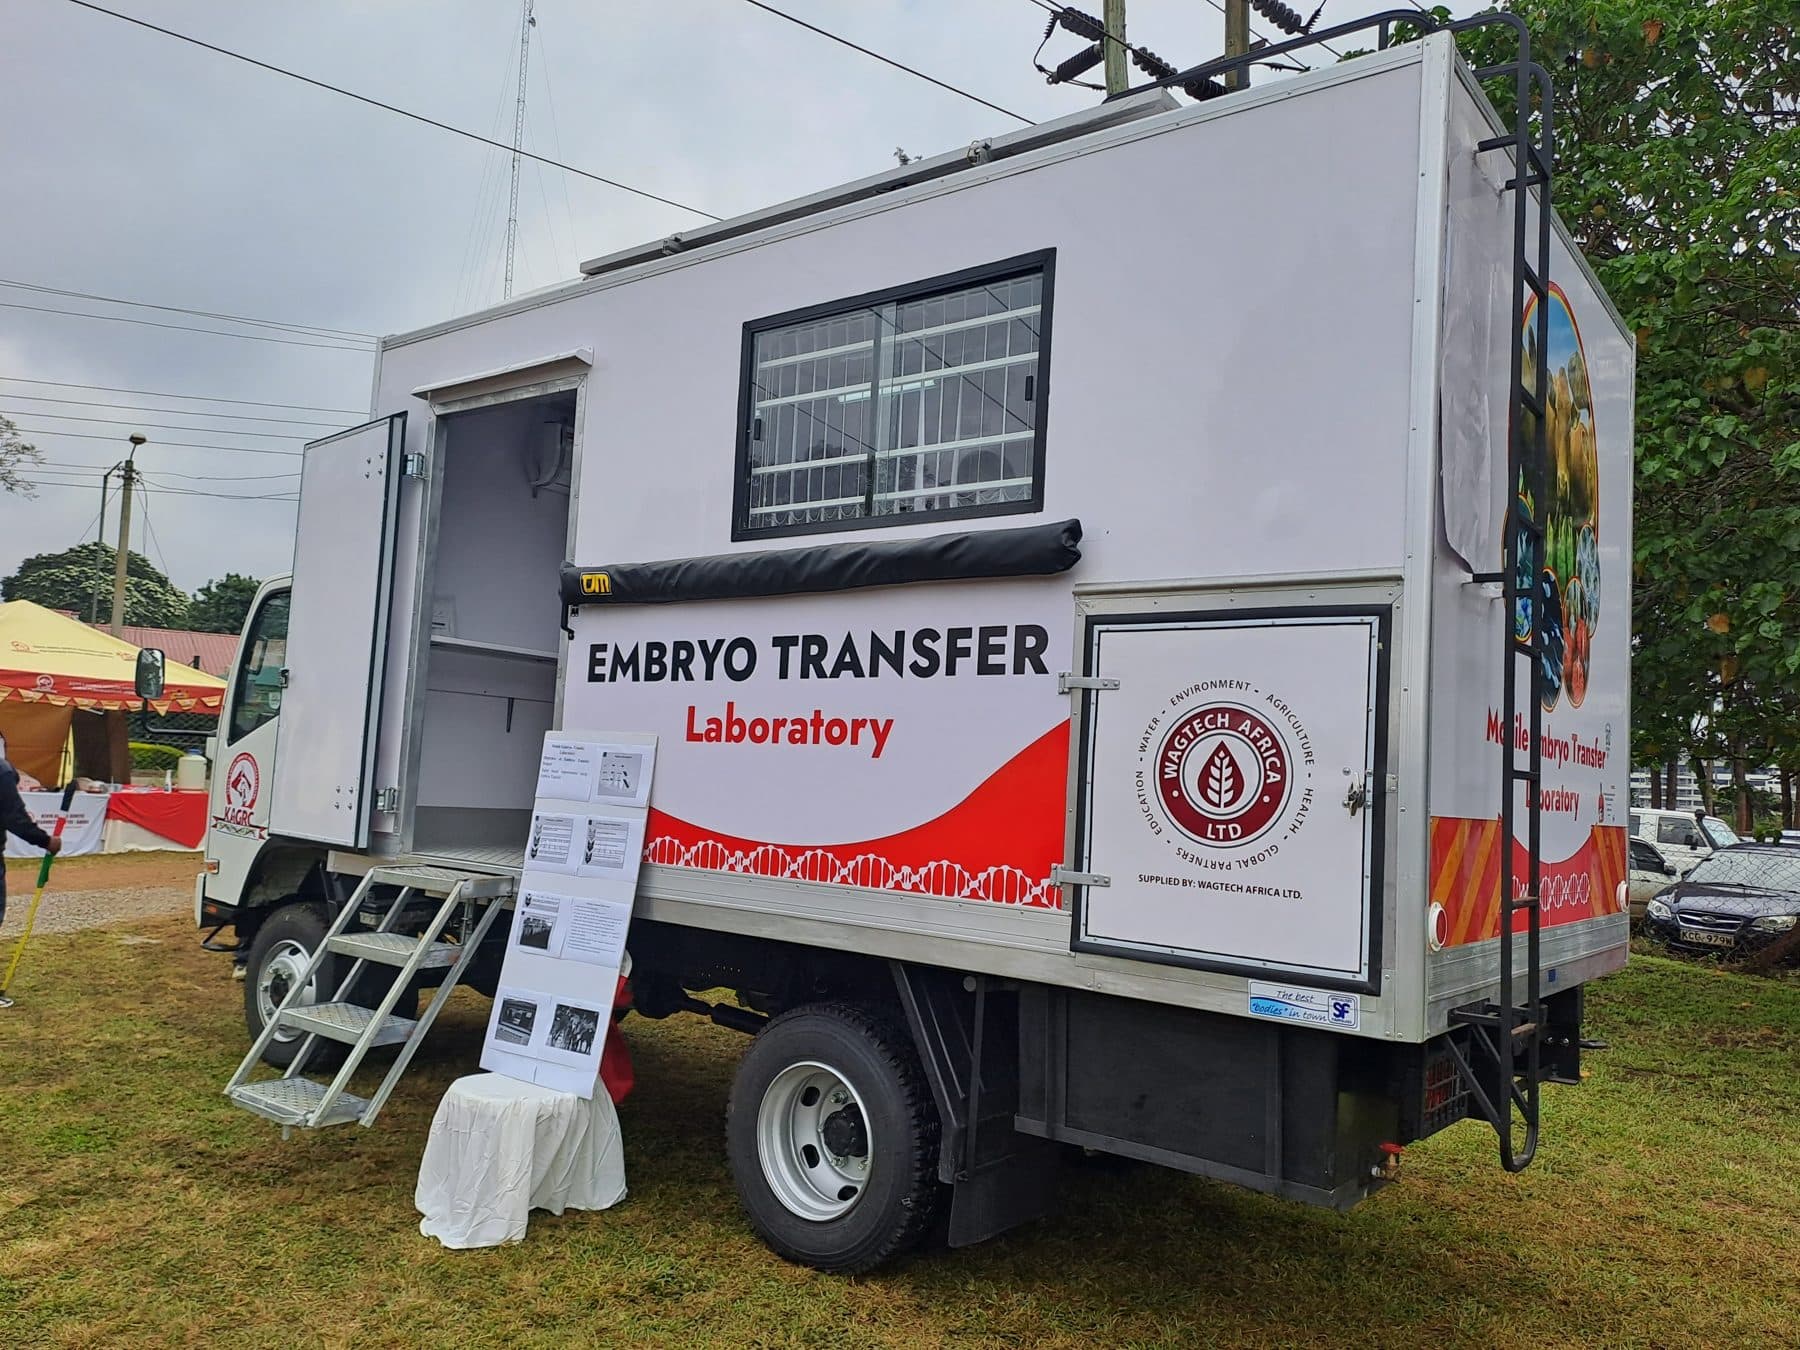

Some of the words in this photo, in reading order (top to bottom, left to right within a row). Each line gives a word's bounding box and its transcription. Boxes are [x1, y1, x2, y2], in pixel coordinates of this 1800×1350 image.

[586, 636, 758, 683] EMBRYO
[771, 624, 1050, 680] TRANSFER
[1170, 679, 1251, 707] ENVIRONMENT
[685, 701, 895, 759] Laboratory
[1138, 717, 1160, 753] WATER
[1266, 693, 1315, 766] AGRICULTURE
[1486, 705, 1529, 751] Moile
[1540, 724, 1569, 769] mbryo
[1571, 733, 1606, 769] Transfer
[1164, 713, 1230, 779] WAGTECH
[1238, 719, 1281, 784] AFRICA
[1135, 771, 1163, 836] EDUCATION
[1289, 788, 1314, 835] HEALTH
[1526, 780, 1580, 821] Loratory
[1206, 823, 1242, 840] LTD
[1176, 847, 1232, 871] PARTNERS
[1235, 844, 1279, 870] GLOBAL
[1138, 873, 1180, 887] SUPPLIED
[1182, 878, 1196, 889] BY:
[1198, 880, 1243, 894] WAGTECH
[1245, 885, 1281, 898] AFRICA
[1283, 889, 1303, 900] LTD.
[1276, 990, 1292, 1000] The
[1295, 992, 1314, 1003] best
[1333, 1002, 1350, 1019] SF
[1289, 1008, 1300, 1018] in
[1303, 1011, 1327, 1022] town
